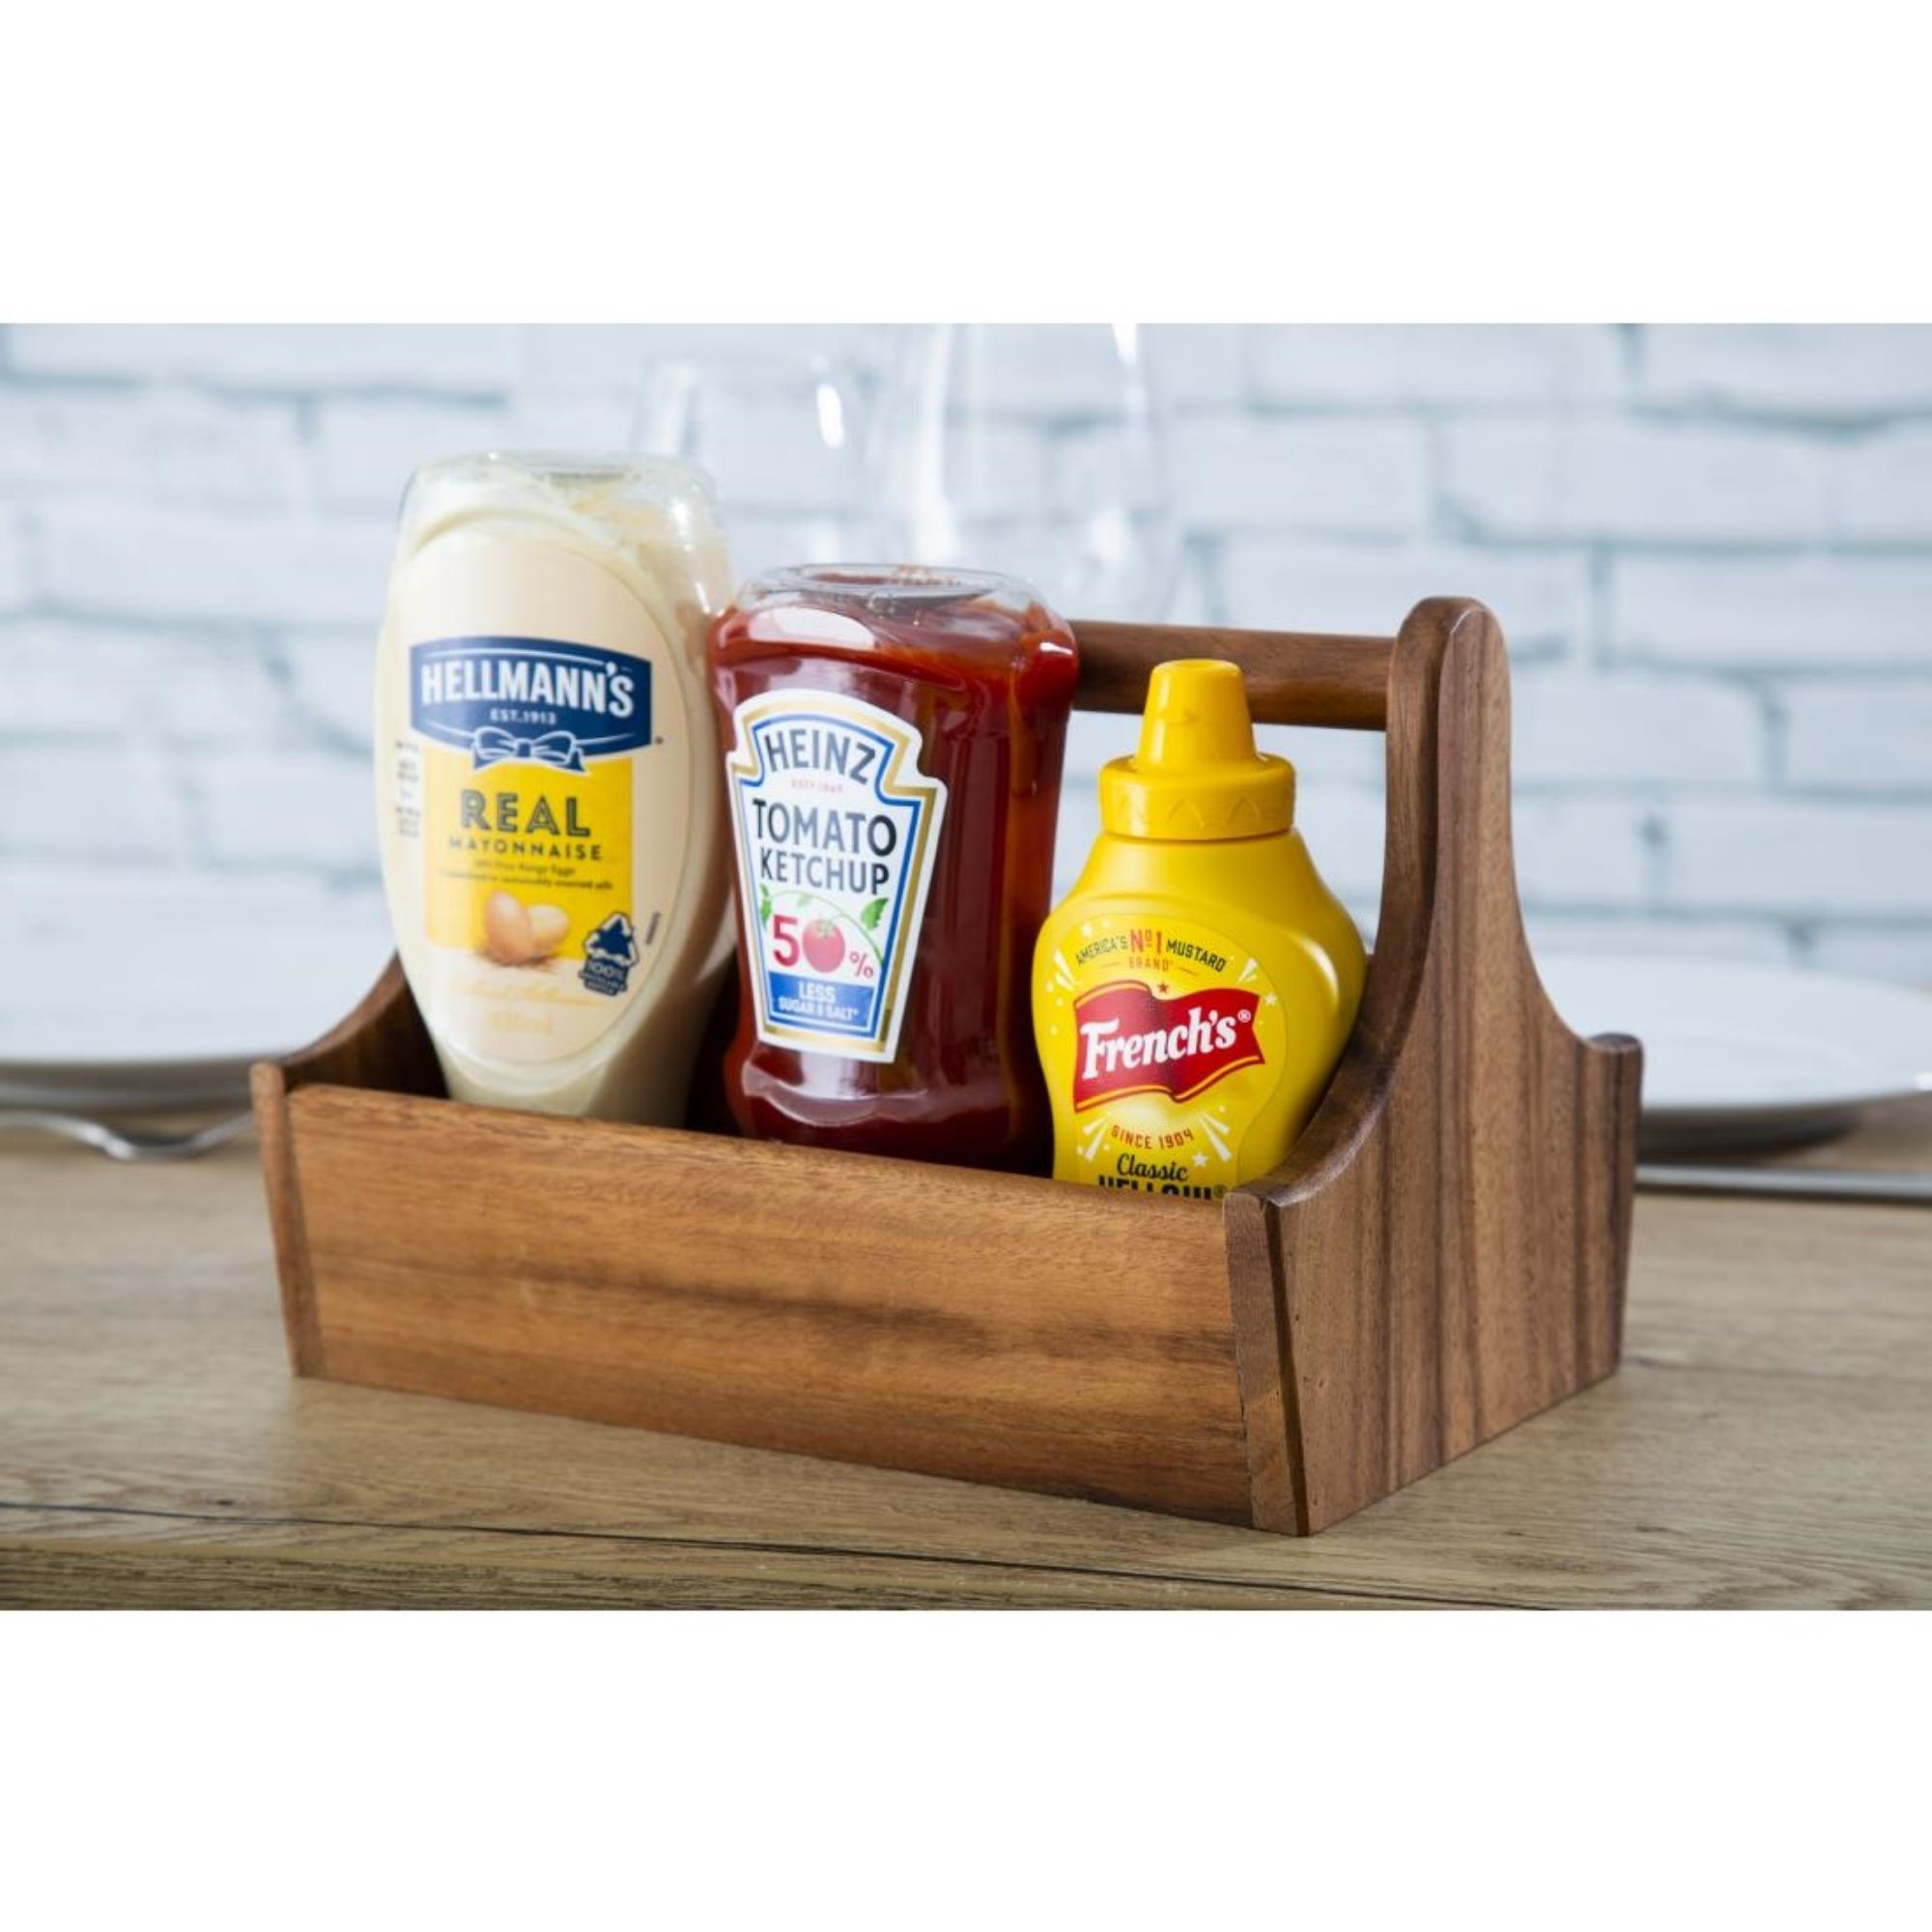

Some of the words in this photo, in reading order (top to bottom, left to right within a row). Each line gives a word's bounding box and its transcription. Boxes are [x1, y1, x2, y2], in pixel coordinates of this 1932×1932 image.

[419, 659, 635, 718] HELLMANN'S
[763, 728, 877, 784] HEINZ
[460, 789, 591, 838] REAL
[752, 799, 897, 857] TOMATO
[448, 836, 603, 861] MAYONNAISE
[759, 846, 891, 895] KETCHUP
[1075, 935, 1128, 965] AMERICA'S
[1166, 937, 1228, 973] MUSTARD
[798, 980, 837, 1003] LESS
[1111, 1124, 1152, 1150] SINCE
[1158, 1128, 1194, 1150] 1904
[1117, 1152, 1189, 1181] Classic
